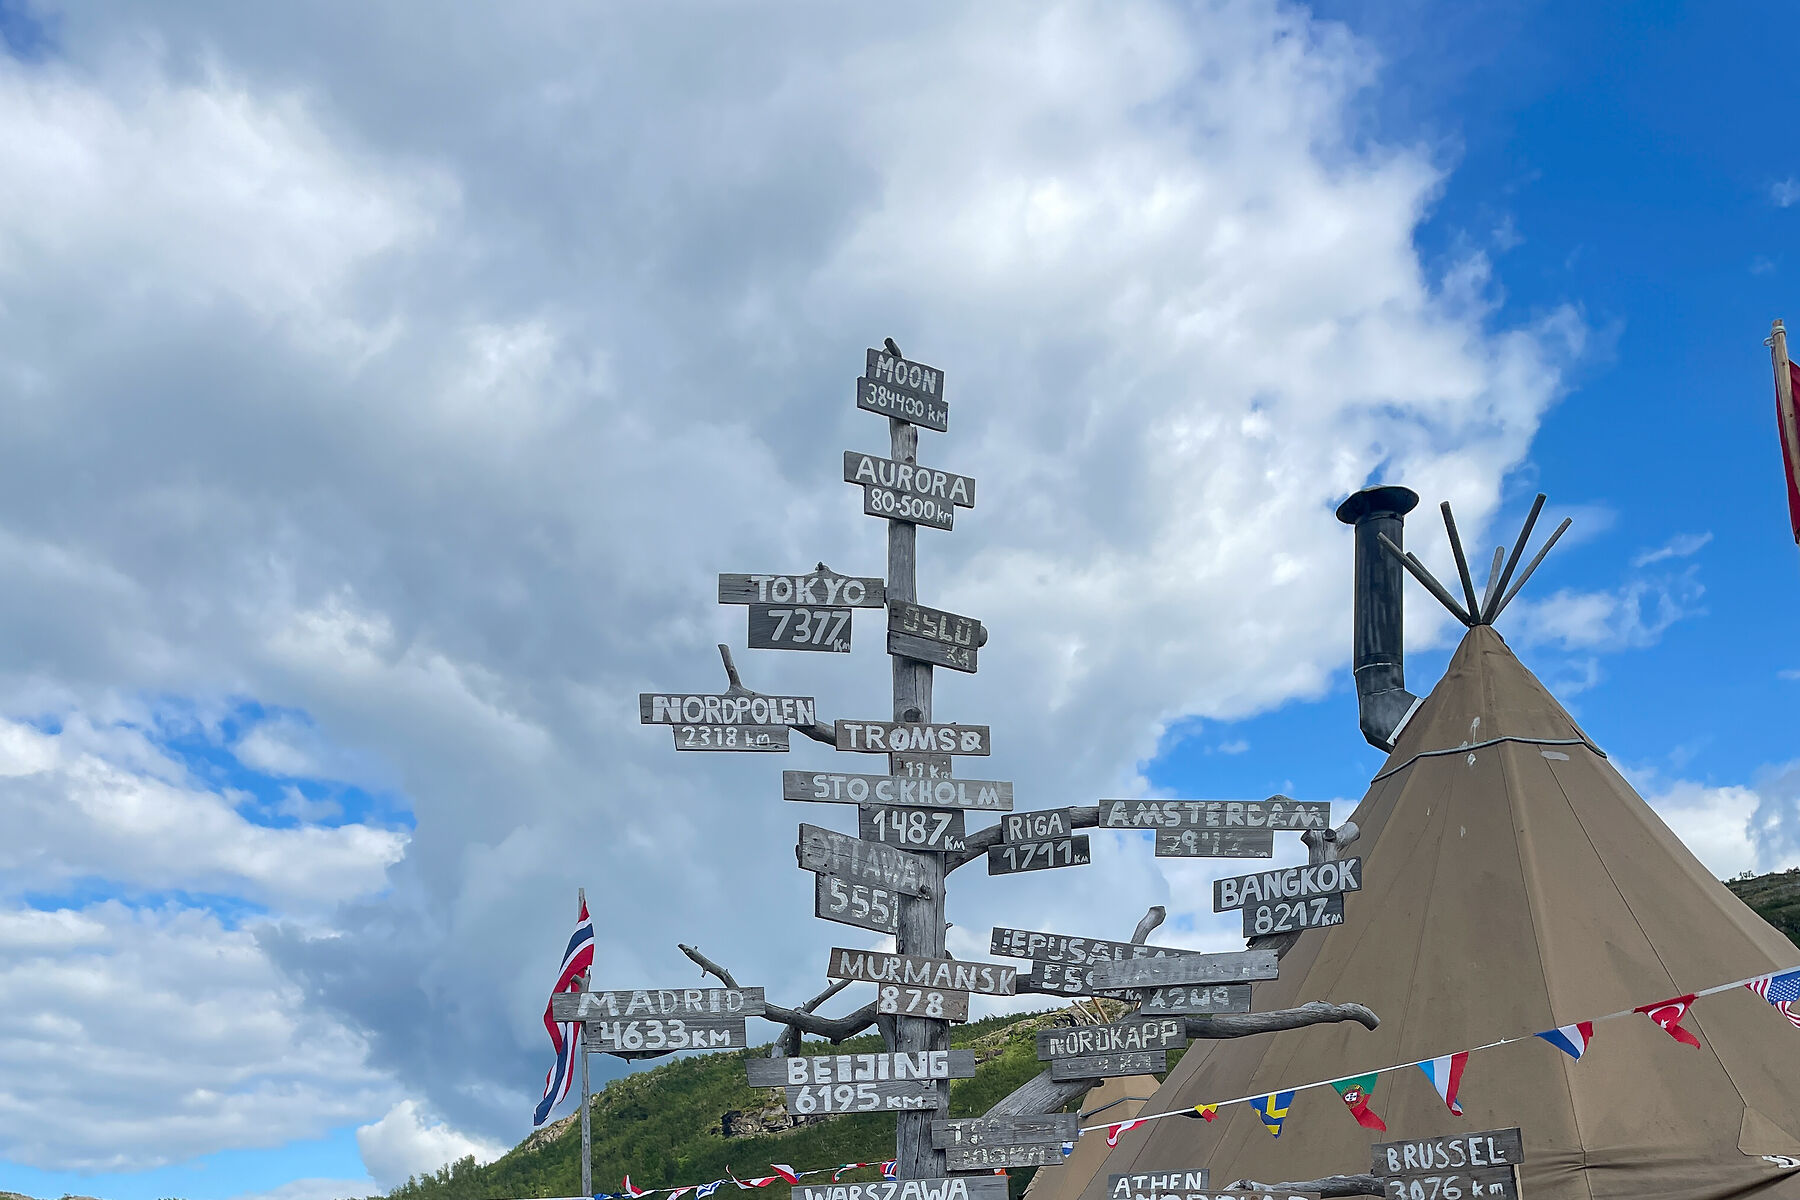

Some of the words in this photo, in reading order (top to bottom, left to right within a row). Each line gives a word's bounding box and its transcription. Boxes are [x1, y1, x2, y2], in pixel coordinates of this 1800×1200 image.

[875, 354, 937, 394] MOON
[866, 383, 924, 418] 384400
[855, 456, 969, 503] AURORA
[750, 575, 866, 606] TOKYO
[904, 606, 972, 645] OSLO
[652, 696, 814, 726] NORDPOLEN
[681, 725, 737, 748] 2318
[812, 774, 999, 806] STOCKHOLM
[1107, 801, 1324, 827] AMSTERDAM
[1221, 858, 1359, 909] BANGKOK
[840, 951, 1016, 995] MURMANSK
[578, 988, 745, 1017] MADRID
[880, 985, 944, 1018] 878
[1050, 1021, 1178, 1055] NORDKAPP
[794, 1084, 880, 1115] 6195
[1386, 1136, 1508, 1173] BRUSSEL
[1112, 1172, 1202, 1199] ATHEN
